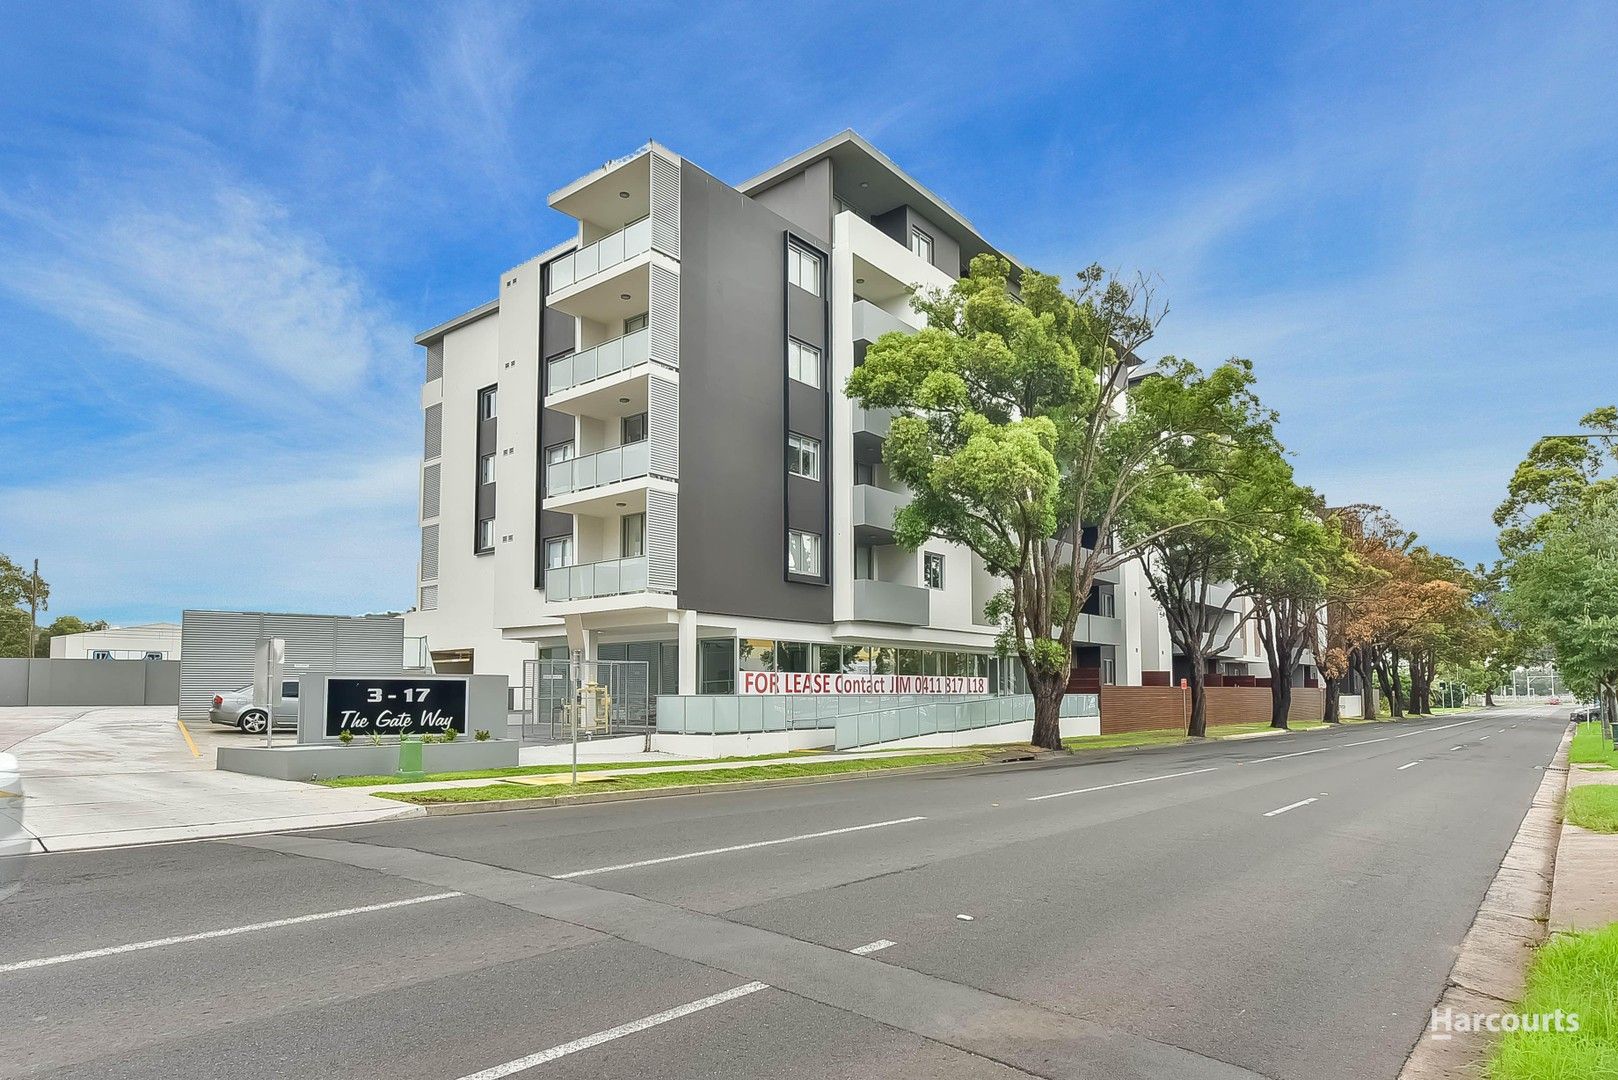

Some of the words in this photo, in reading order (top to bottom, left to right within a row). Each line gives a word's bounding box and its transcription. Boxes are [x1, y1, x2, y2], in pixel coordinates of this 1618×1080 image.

[745, 673, 779, 694] FOR
[785, 674, 831, 694] LEASE
[835, 675, 885, 694] Contact
[890, 676, 911, 694] JIM
[915, 677, 942, 694] 0411
[946, 677, 964, 694] 817
[968, 678, 984, 694] 118
[367, 688, 382, 703] 3
[403, 688, 431, 703] 17
[340, 710, 369, 728] The
[375, 709, 413, 728] Gate
[420, 709, 453, 731] Way
